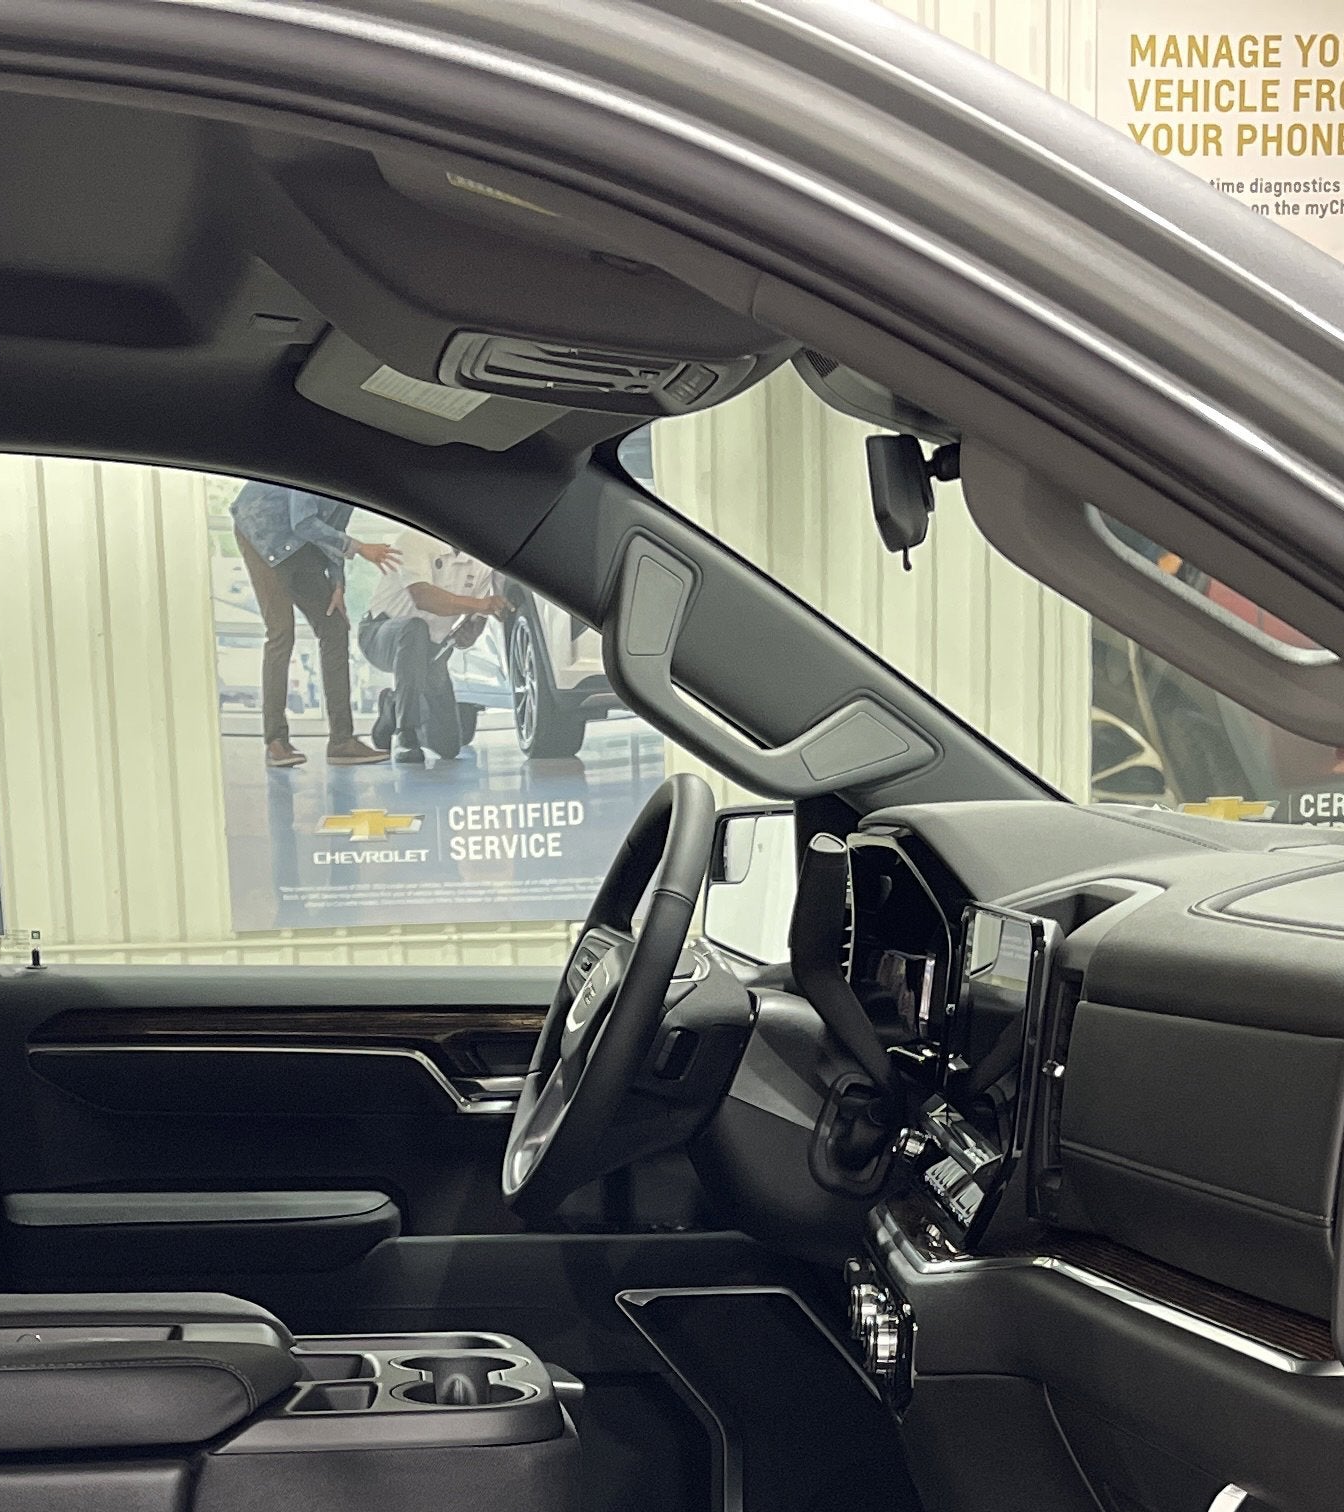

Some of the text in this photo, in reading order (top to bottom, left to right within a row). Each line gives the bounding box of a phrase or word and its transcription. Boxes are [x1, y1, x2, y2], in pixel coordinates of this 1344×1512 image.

[1130, 34, 1283, 68] MANAGE
[1128, 79, 1281, 113] VEHICLE
[1127, 123, 1224, 156] YOUR
[1249, 176, 1341, 198] diagnostics
[1251, 203, 1270, 216] on
[1274, 200, 1301, 216] the
[448, 801, 585, 832] CERTIFIED
[312, 849, 430, 865] CHEVROLET
[449, 832, 563, 862] SERVICE
